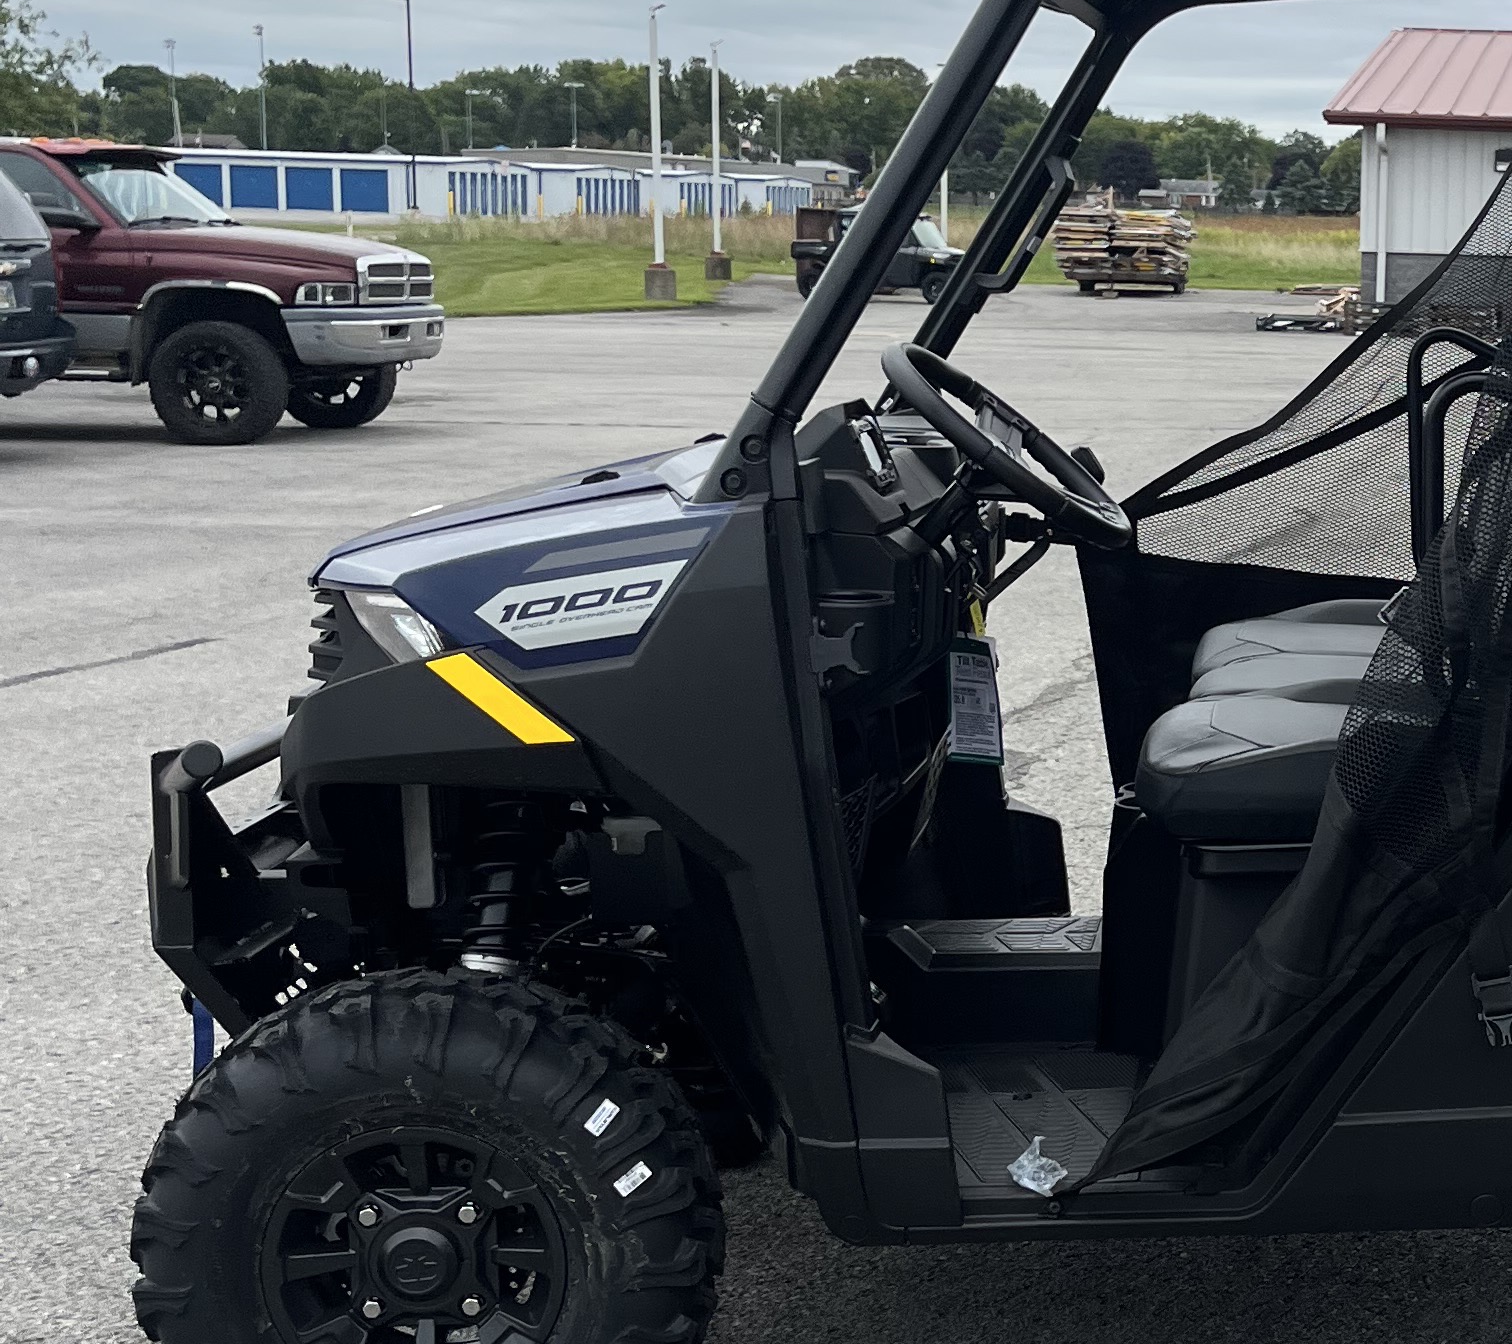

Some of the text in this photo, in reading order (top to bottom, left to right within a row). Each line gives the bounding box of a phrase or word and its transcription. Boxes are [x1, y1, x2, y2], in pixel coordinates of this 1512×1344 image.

[499, 579, 663, 623] 1000
[511, 603, 654, 632] SINGLE OVERHEAD CAM
